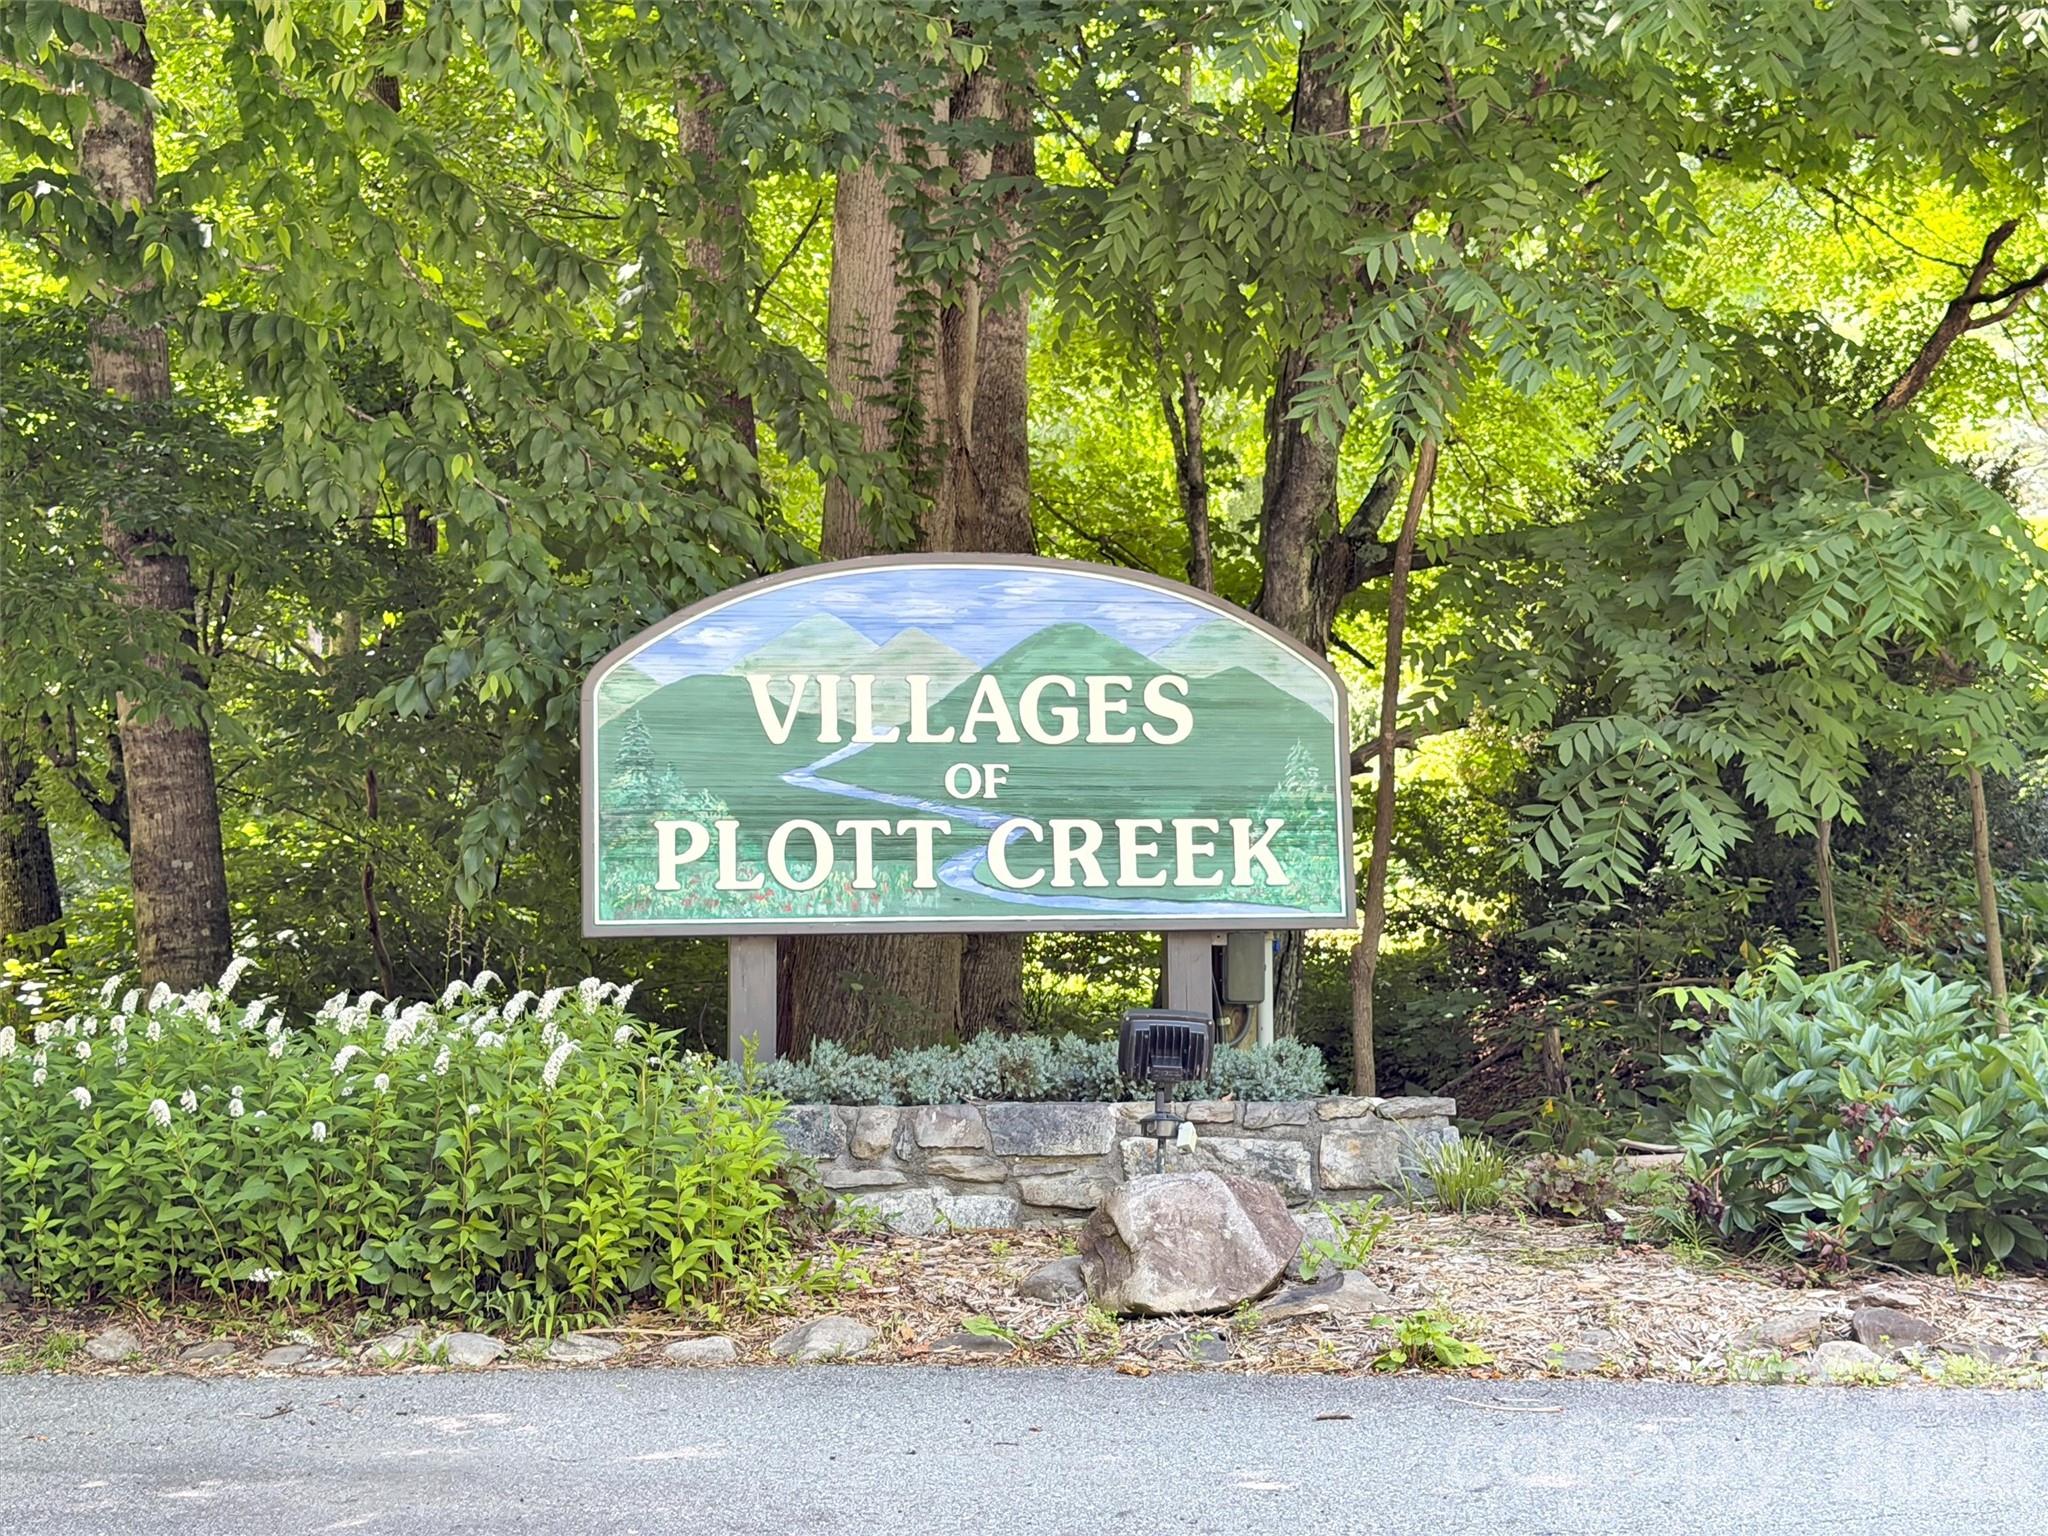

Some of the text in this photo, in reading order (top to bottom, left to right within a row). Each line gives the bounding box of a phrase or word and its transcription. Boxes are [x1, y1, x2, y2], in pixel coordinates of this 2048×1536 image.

[745, 672, 1195, 746] VILLAGES
[943, 761, 1010, 799] OF
[653, 817, 1290, 891] PLOTT CREEK
